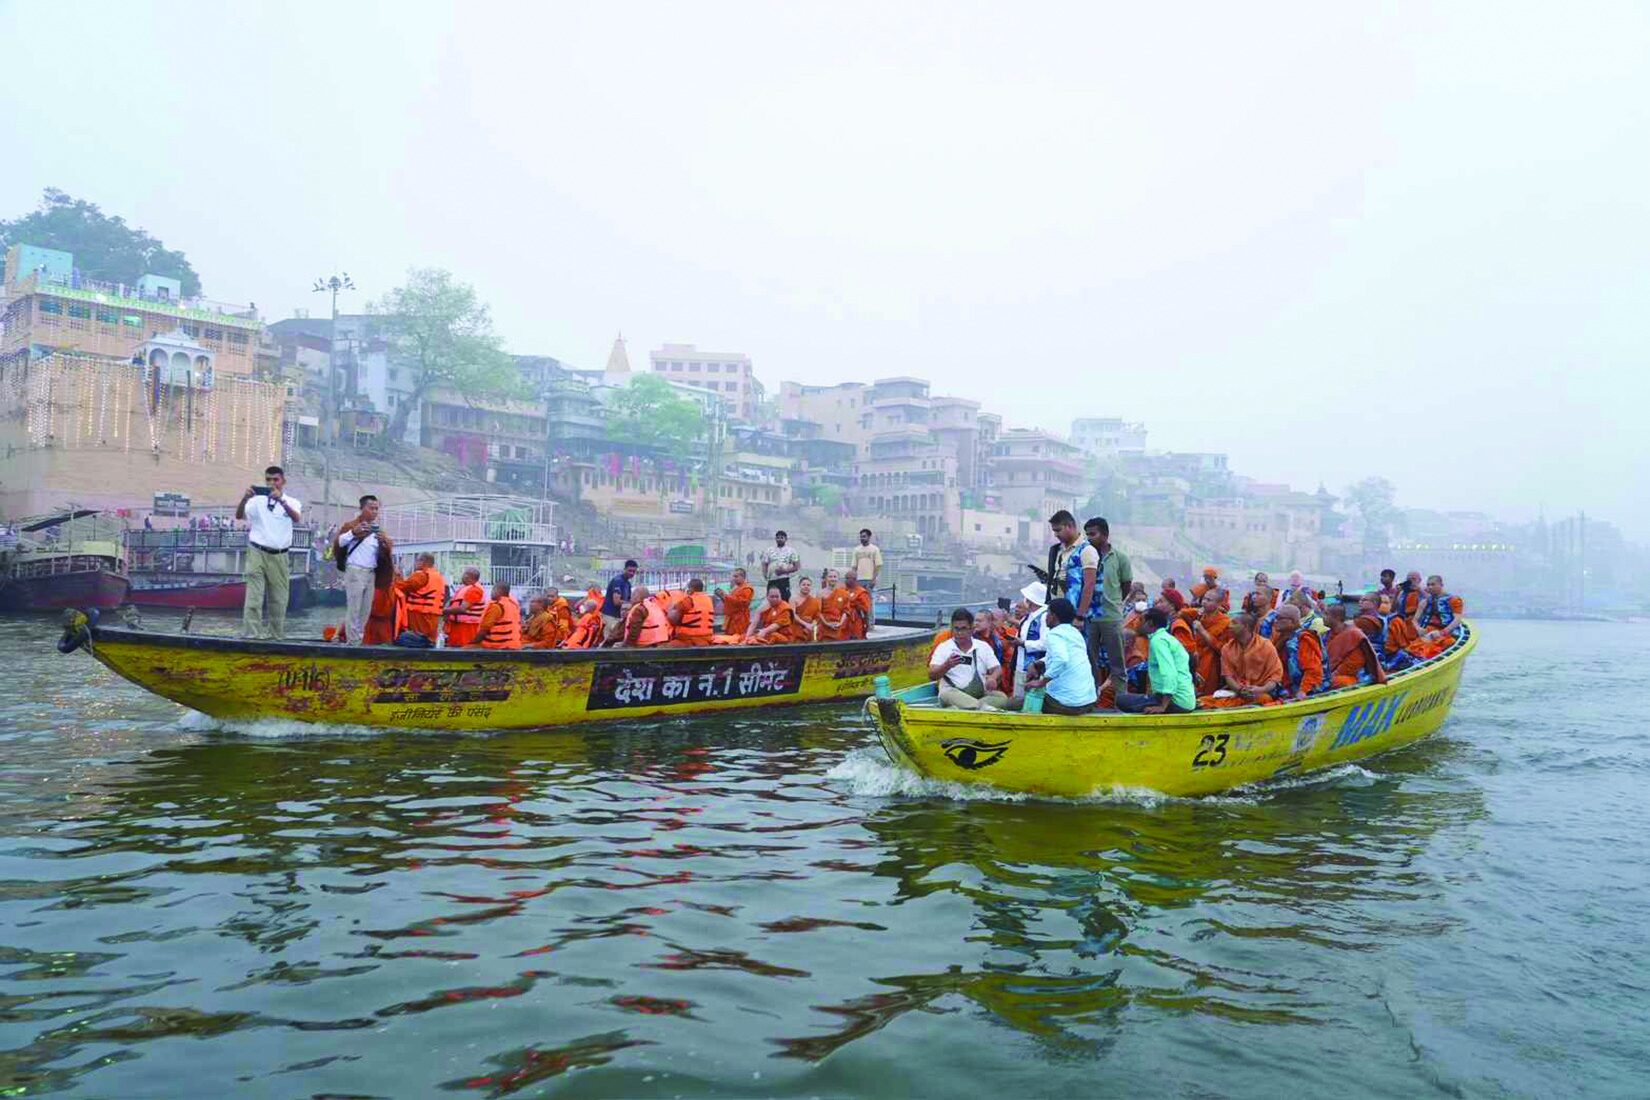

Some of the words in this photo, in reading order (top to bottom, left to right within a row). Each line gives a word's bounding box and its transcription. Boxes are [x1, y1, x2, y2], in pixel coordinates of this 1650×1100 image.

[614, 668, 656, 704] देश
[661, 675, 692, 699] का
[738, 661, 788, 695] सीमेंट
[1192, 732, 1231, 767] 23
